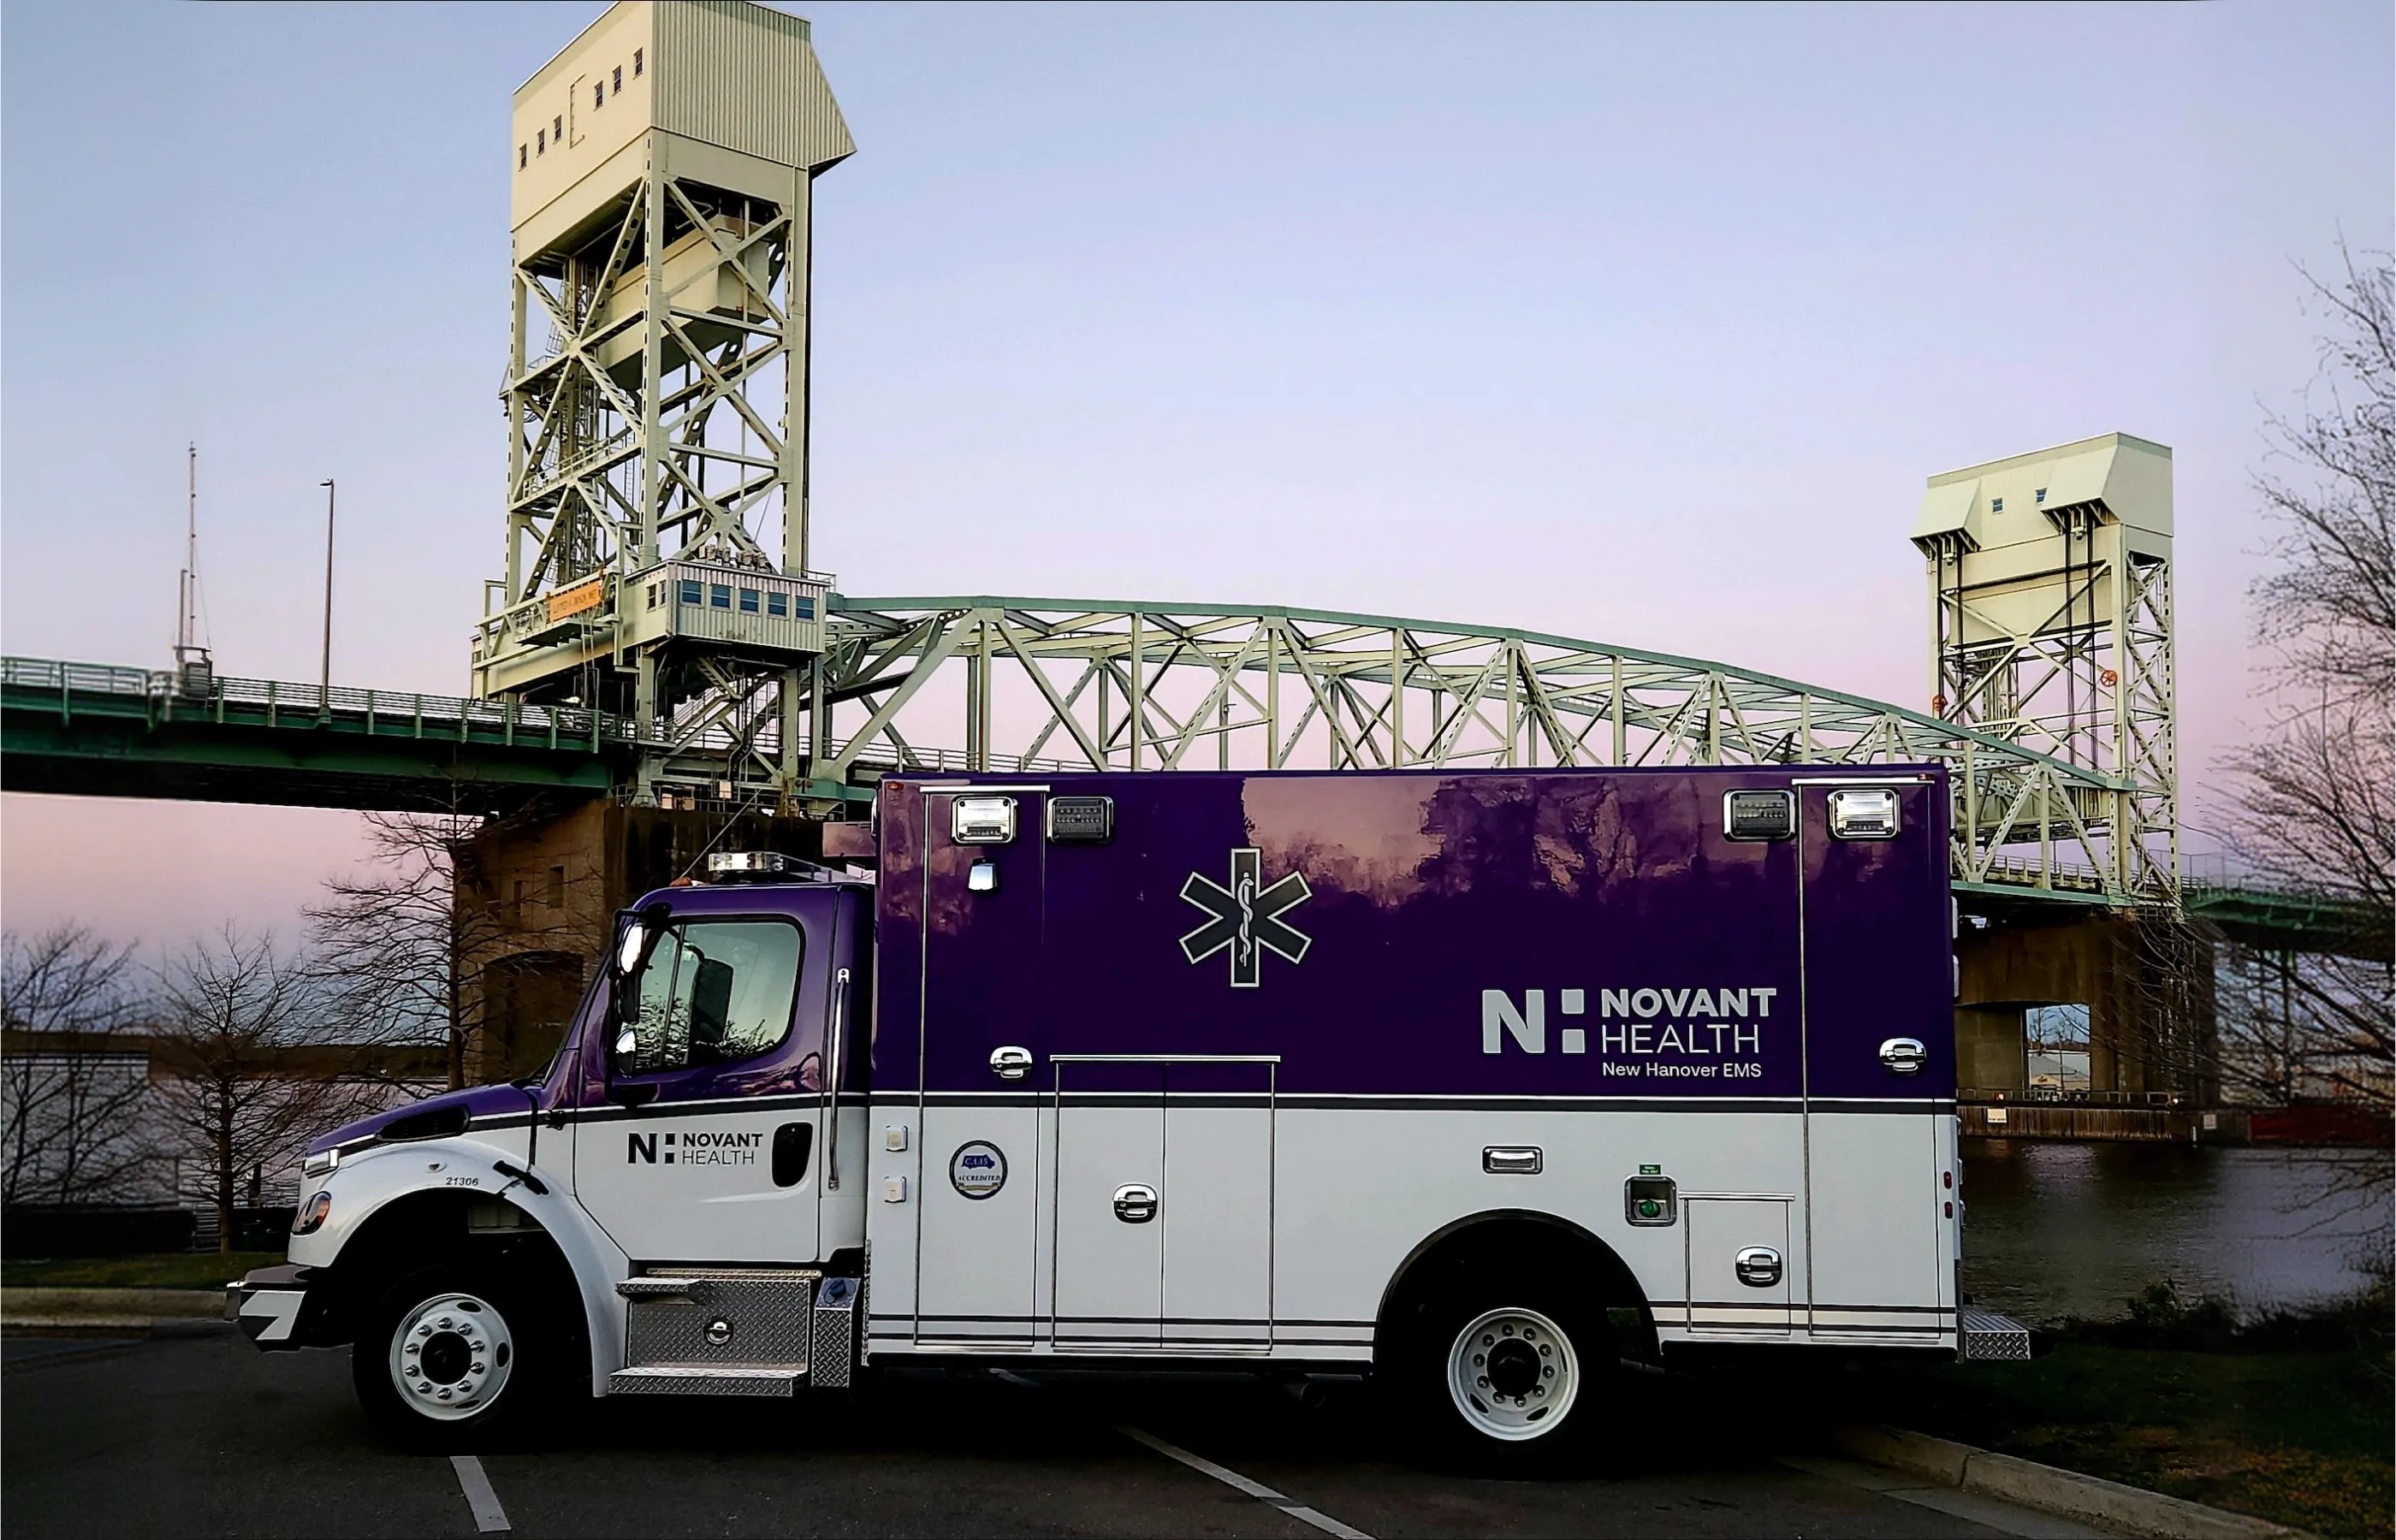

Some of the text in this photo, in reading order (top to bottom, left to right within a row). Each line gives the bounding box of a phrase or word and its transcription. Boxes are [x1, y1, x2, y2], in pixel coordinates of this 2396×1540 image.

[1601, 988, 1777, 1018] NOVANT
[1601, 1024, 1759, 1054] HEALTH
[1603, 1062, 1762, 1078] New Hanover EMS
[683, 1133, 763, 1147] NOVANT
[682, 1150, 755, 1164] HEALTH
[446, 1176, 479, 1186] 21306
